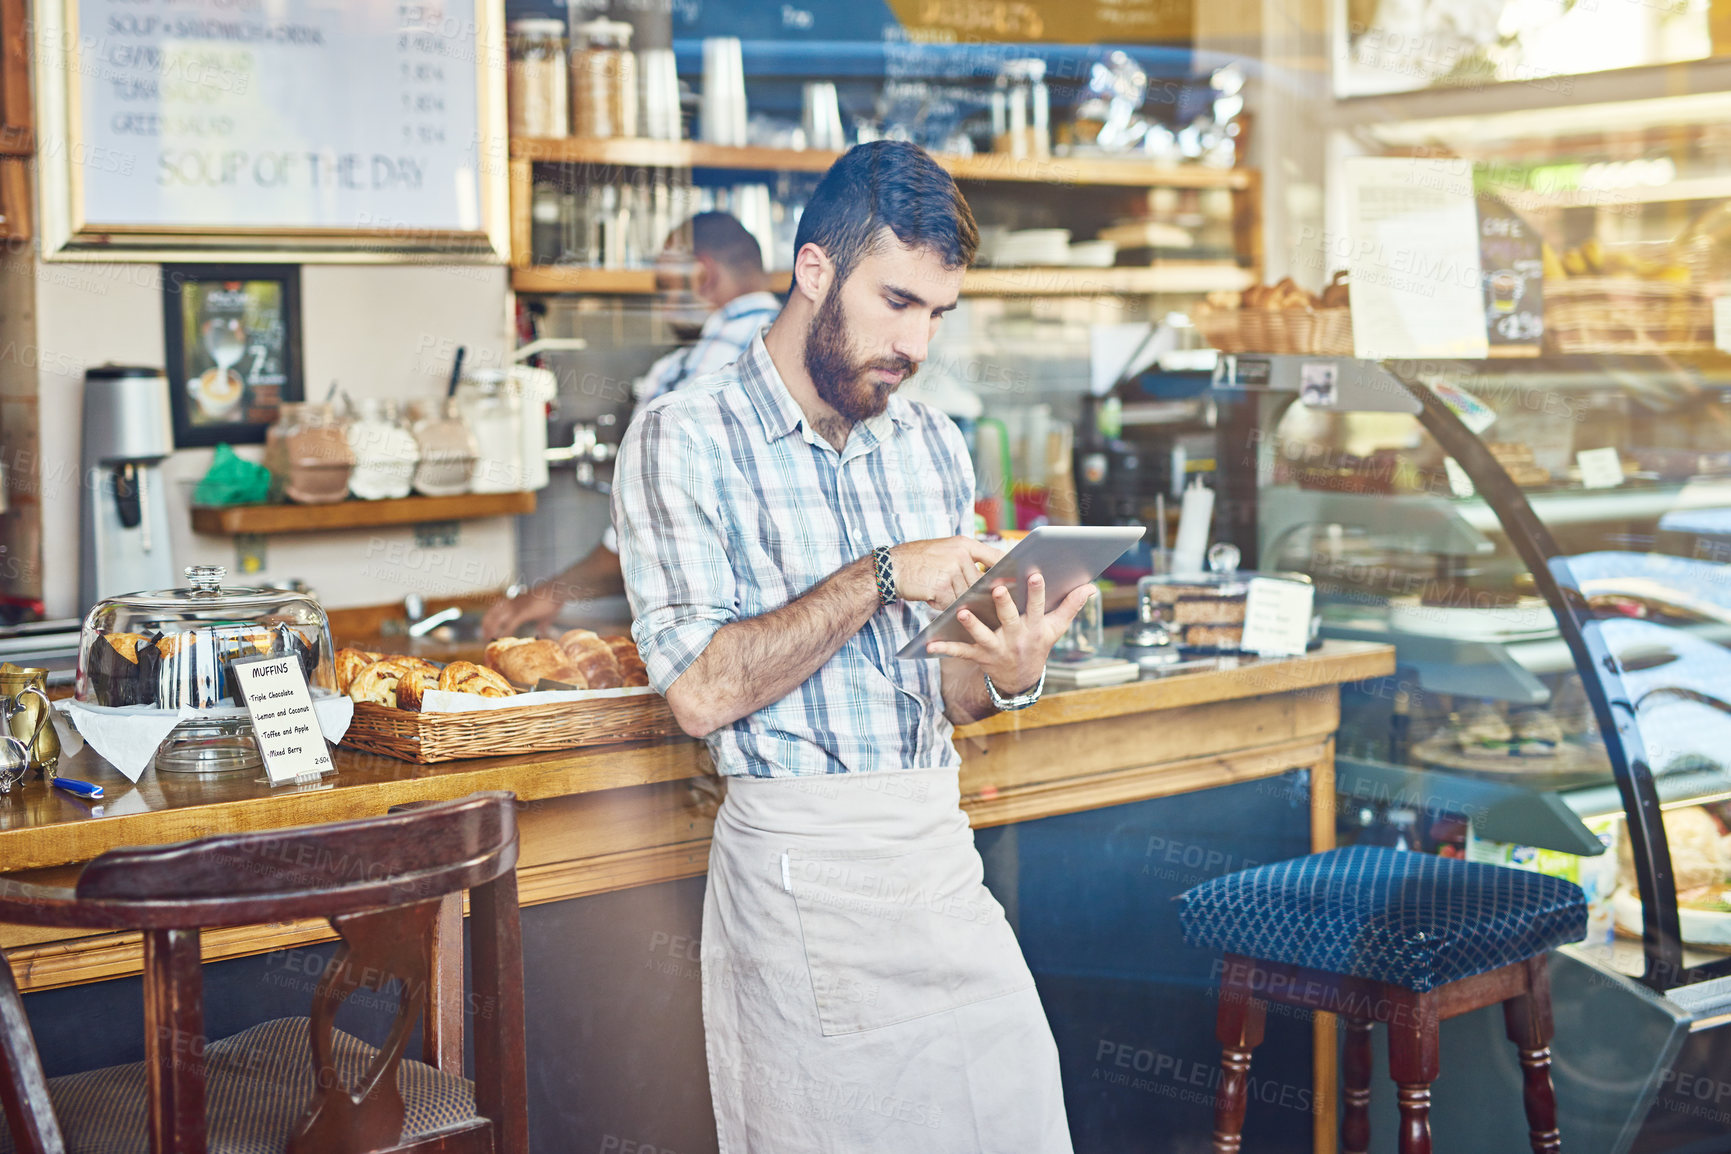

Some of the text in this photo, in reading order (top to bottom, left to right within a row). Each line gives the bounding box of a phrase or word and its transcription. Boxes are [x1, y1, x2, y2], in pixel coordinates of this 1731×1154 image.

[155, 148, 430, 192] SOUP OF THE DAY
[252, 662, 288, 679] MUFFINS
[269, 689, 294, 699] Chocolate
[277, 709, 287, 717] and
[288, 705, 309, 715] Coconut
[283, 727, 293, 736] and
[294, 724, 309, 734] Apple
[287, 745, 302, 754] Berry
